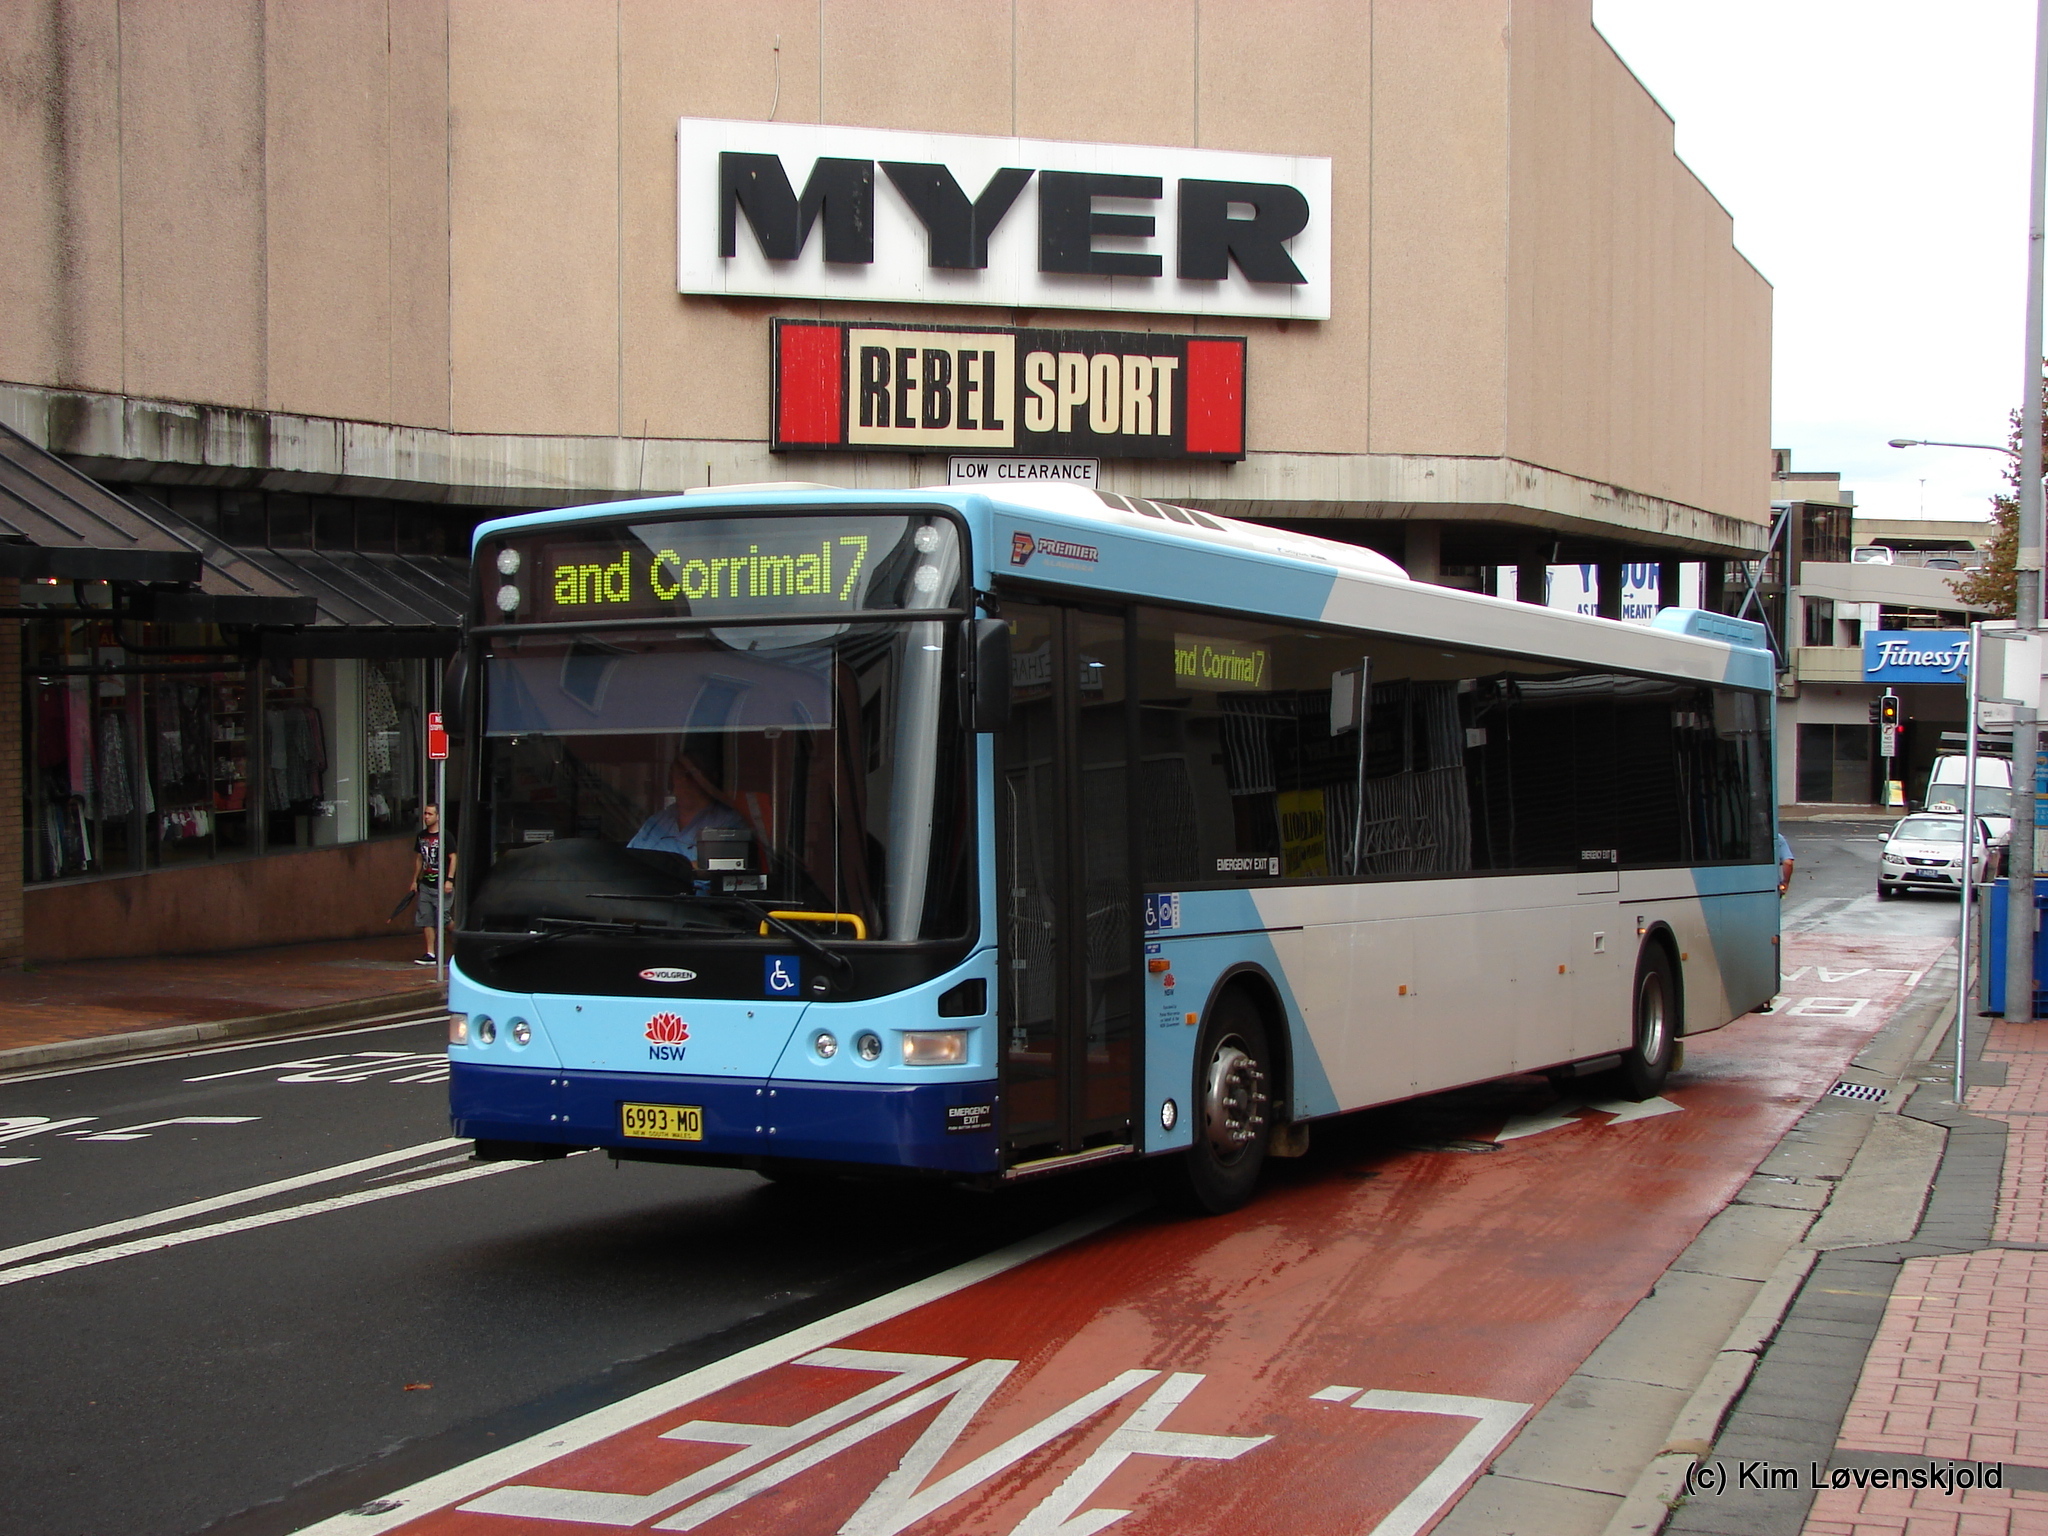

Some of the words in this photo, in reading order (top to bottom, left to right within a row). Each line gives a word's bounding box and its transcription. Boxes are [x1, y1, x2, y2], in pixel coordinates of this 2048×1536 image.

[718, 151, 1310, 284] MYER
[859, 346, 1004, 430] REBEL
[1024, 351, 1178, 436] SPORT
[957, 463, 988, 478] LOW
[998, 463, 1091, 480] CLEARANCE
[1038, 538, 1098, 562] PREMIER
[555, 551, 630, 604] and
[650, 541, 831, 600] Corrimal
[840, 535, 867, 600] 7
[1623, 604, 1652, 619] MEANT
[1175, 645, 1197, 676] and
[1202, 646, 1255, 682] Corrimal
[1217, 858, 1253, 871] EMERGENCY
[1254, 857, 1268, 870] EXIT
[655, 971, 693, 979] VOLGREN
[649, 1046, 686, 1061] NSW
[949, 1105, 990, 1117] EMERGENCY
[963, 1116, 979, 1124] EXIT
[456, 1346, 1535, 1536] LANE
